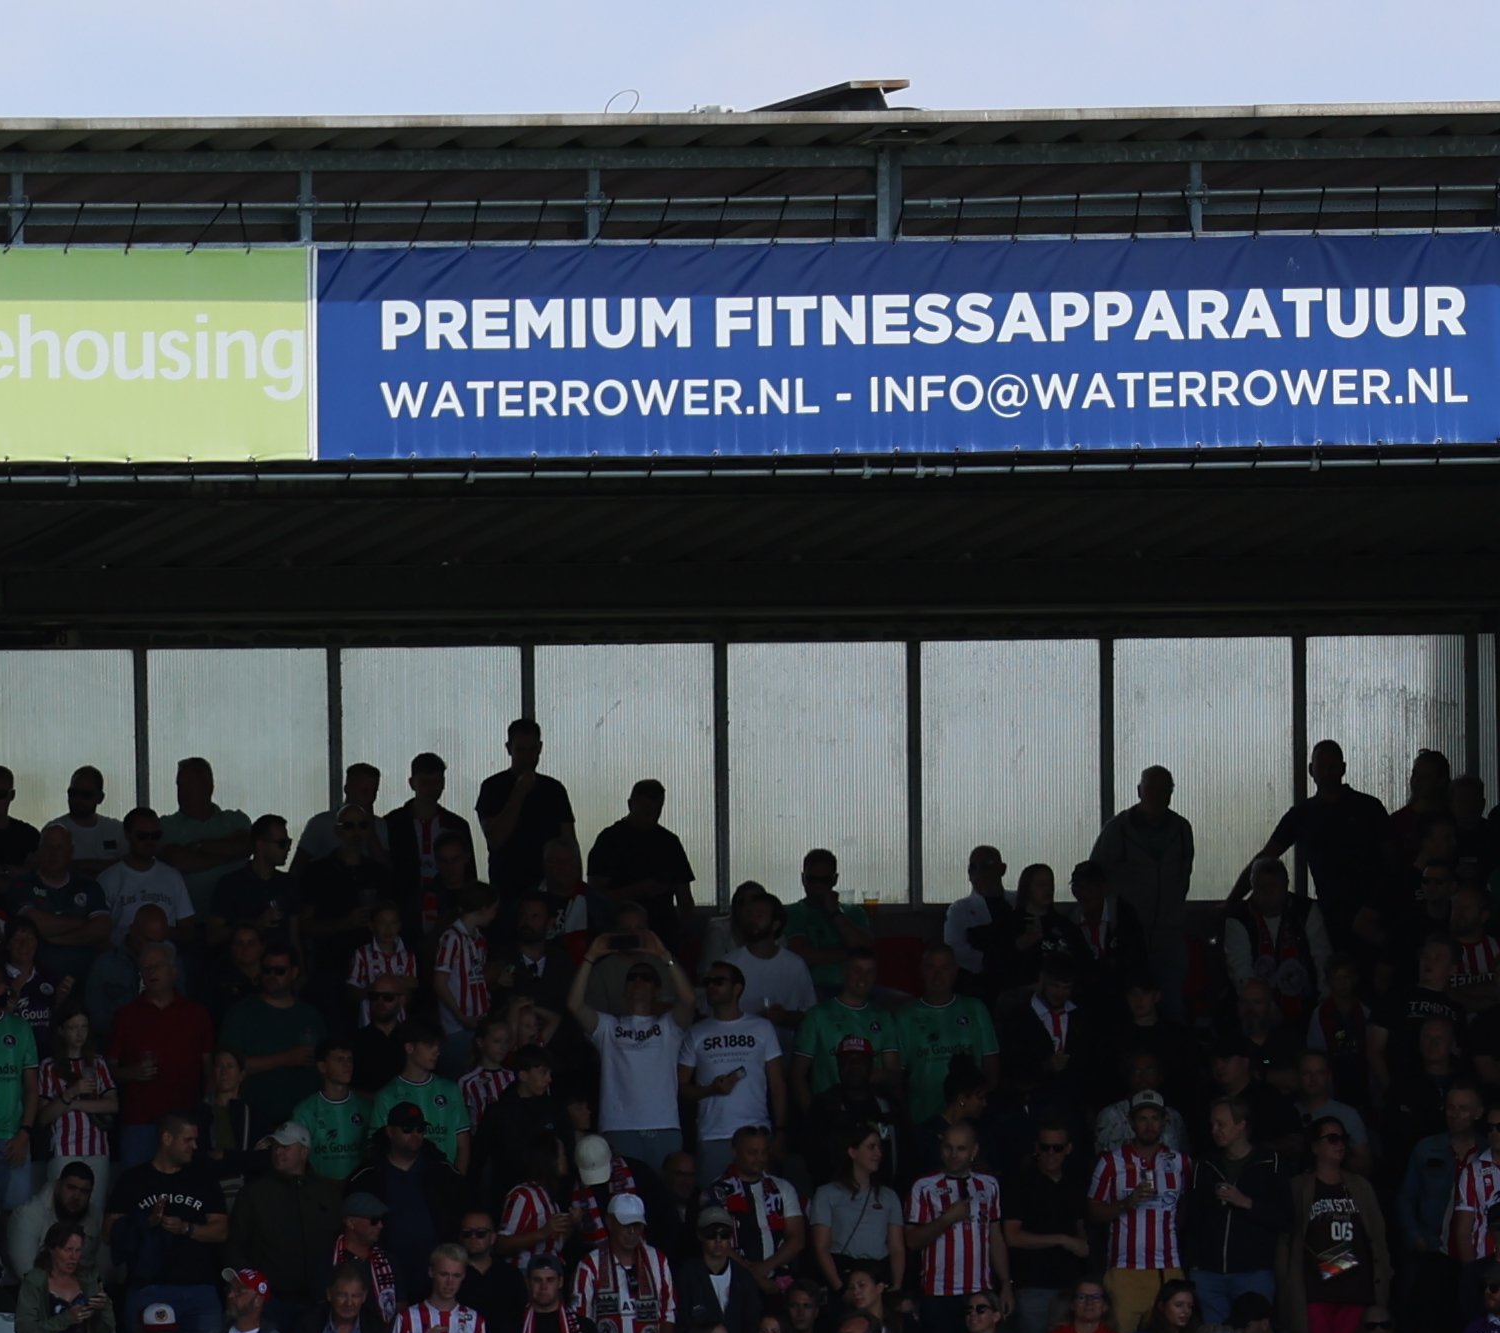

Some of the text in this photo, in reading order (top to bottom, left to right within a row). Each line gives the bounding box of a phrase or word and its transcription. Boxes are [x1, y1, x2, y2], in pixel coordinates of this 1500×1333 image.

[381, 286, 1468, 351] PREMIUM FITNESSAPPARATUUR
[381, 380, 820, 417] WATERROWER.NL
[869, 367, 1470, 418] INFO@WATERROWER.NL
[702, 1035, 756, 1050] SR1888
